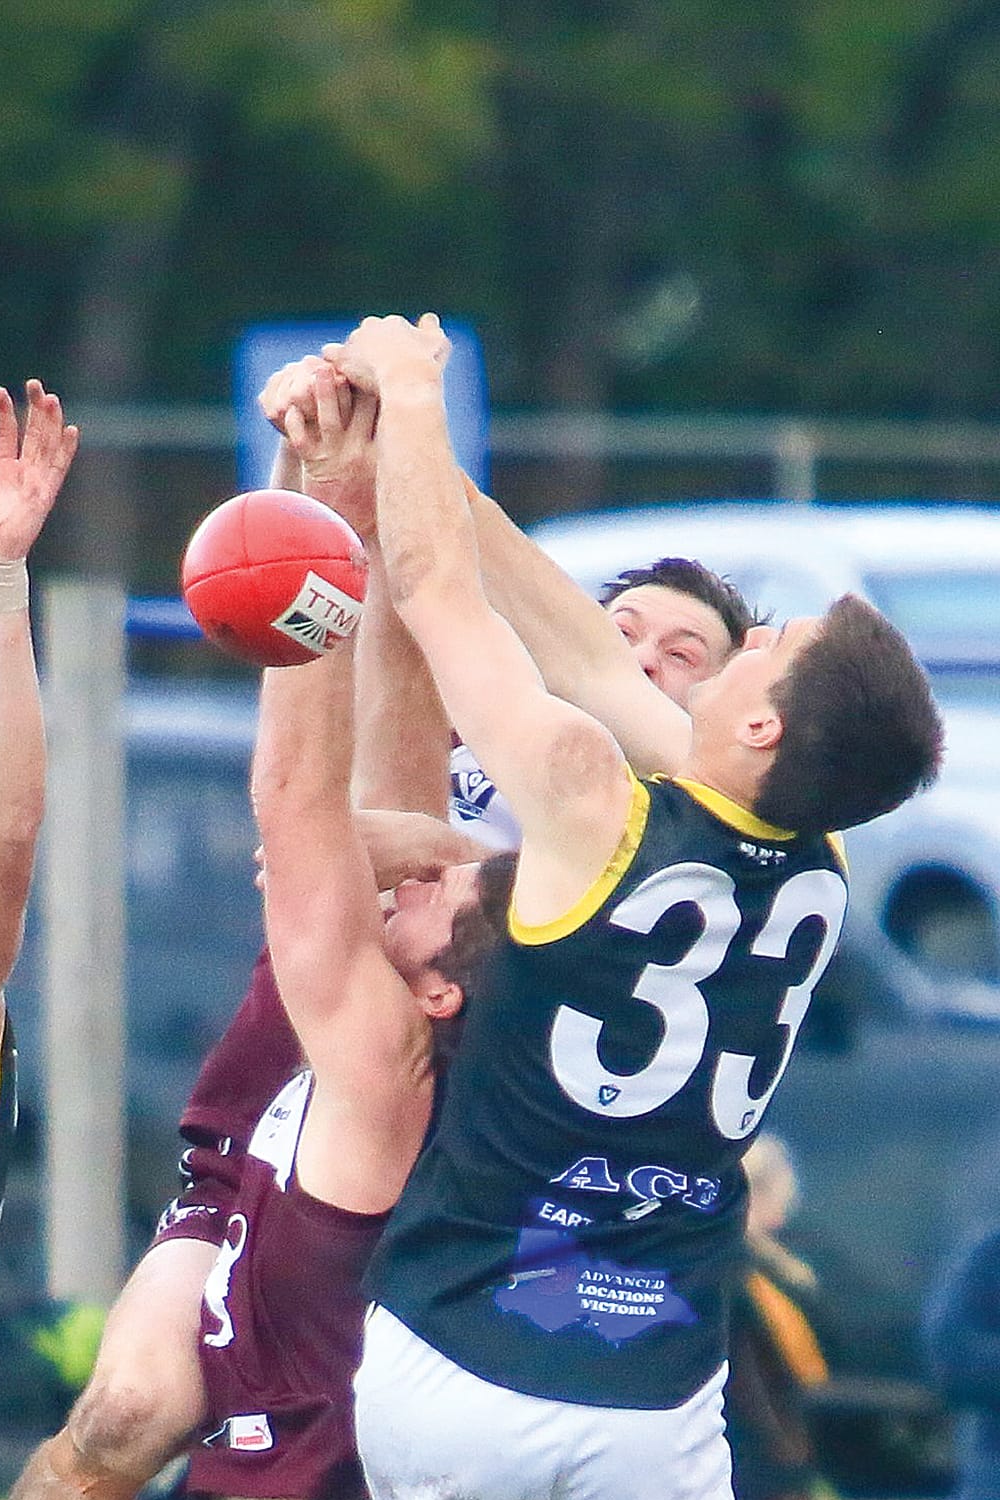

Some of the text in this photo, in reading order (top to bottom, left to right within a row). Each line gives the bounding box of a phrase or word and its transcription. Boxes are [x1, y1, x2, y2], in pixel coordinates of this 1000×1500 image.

[550, 861, 849, 1140] 33
[576, 1283, 666, 1304] LOCATIONS
[580, 1298, 658, 1316] VICTORIA
